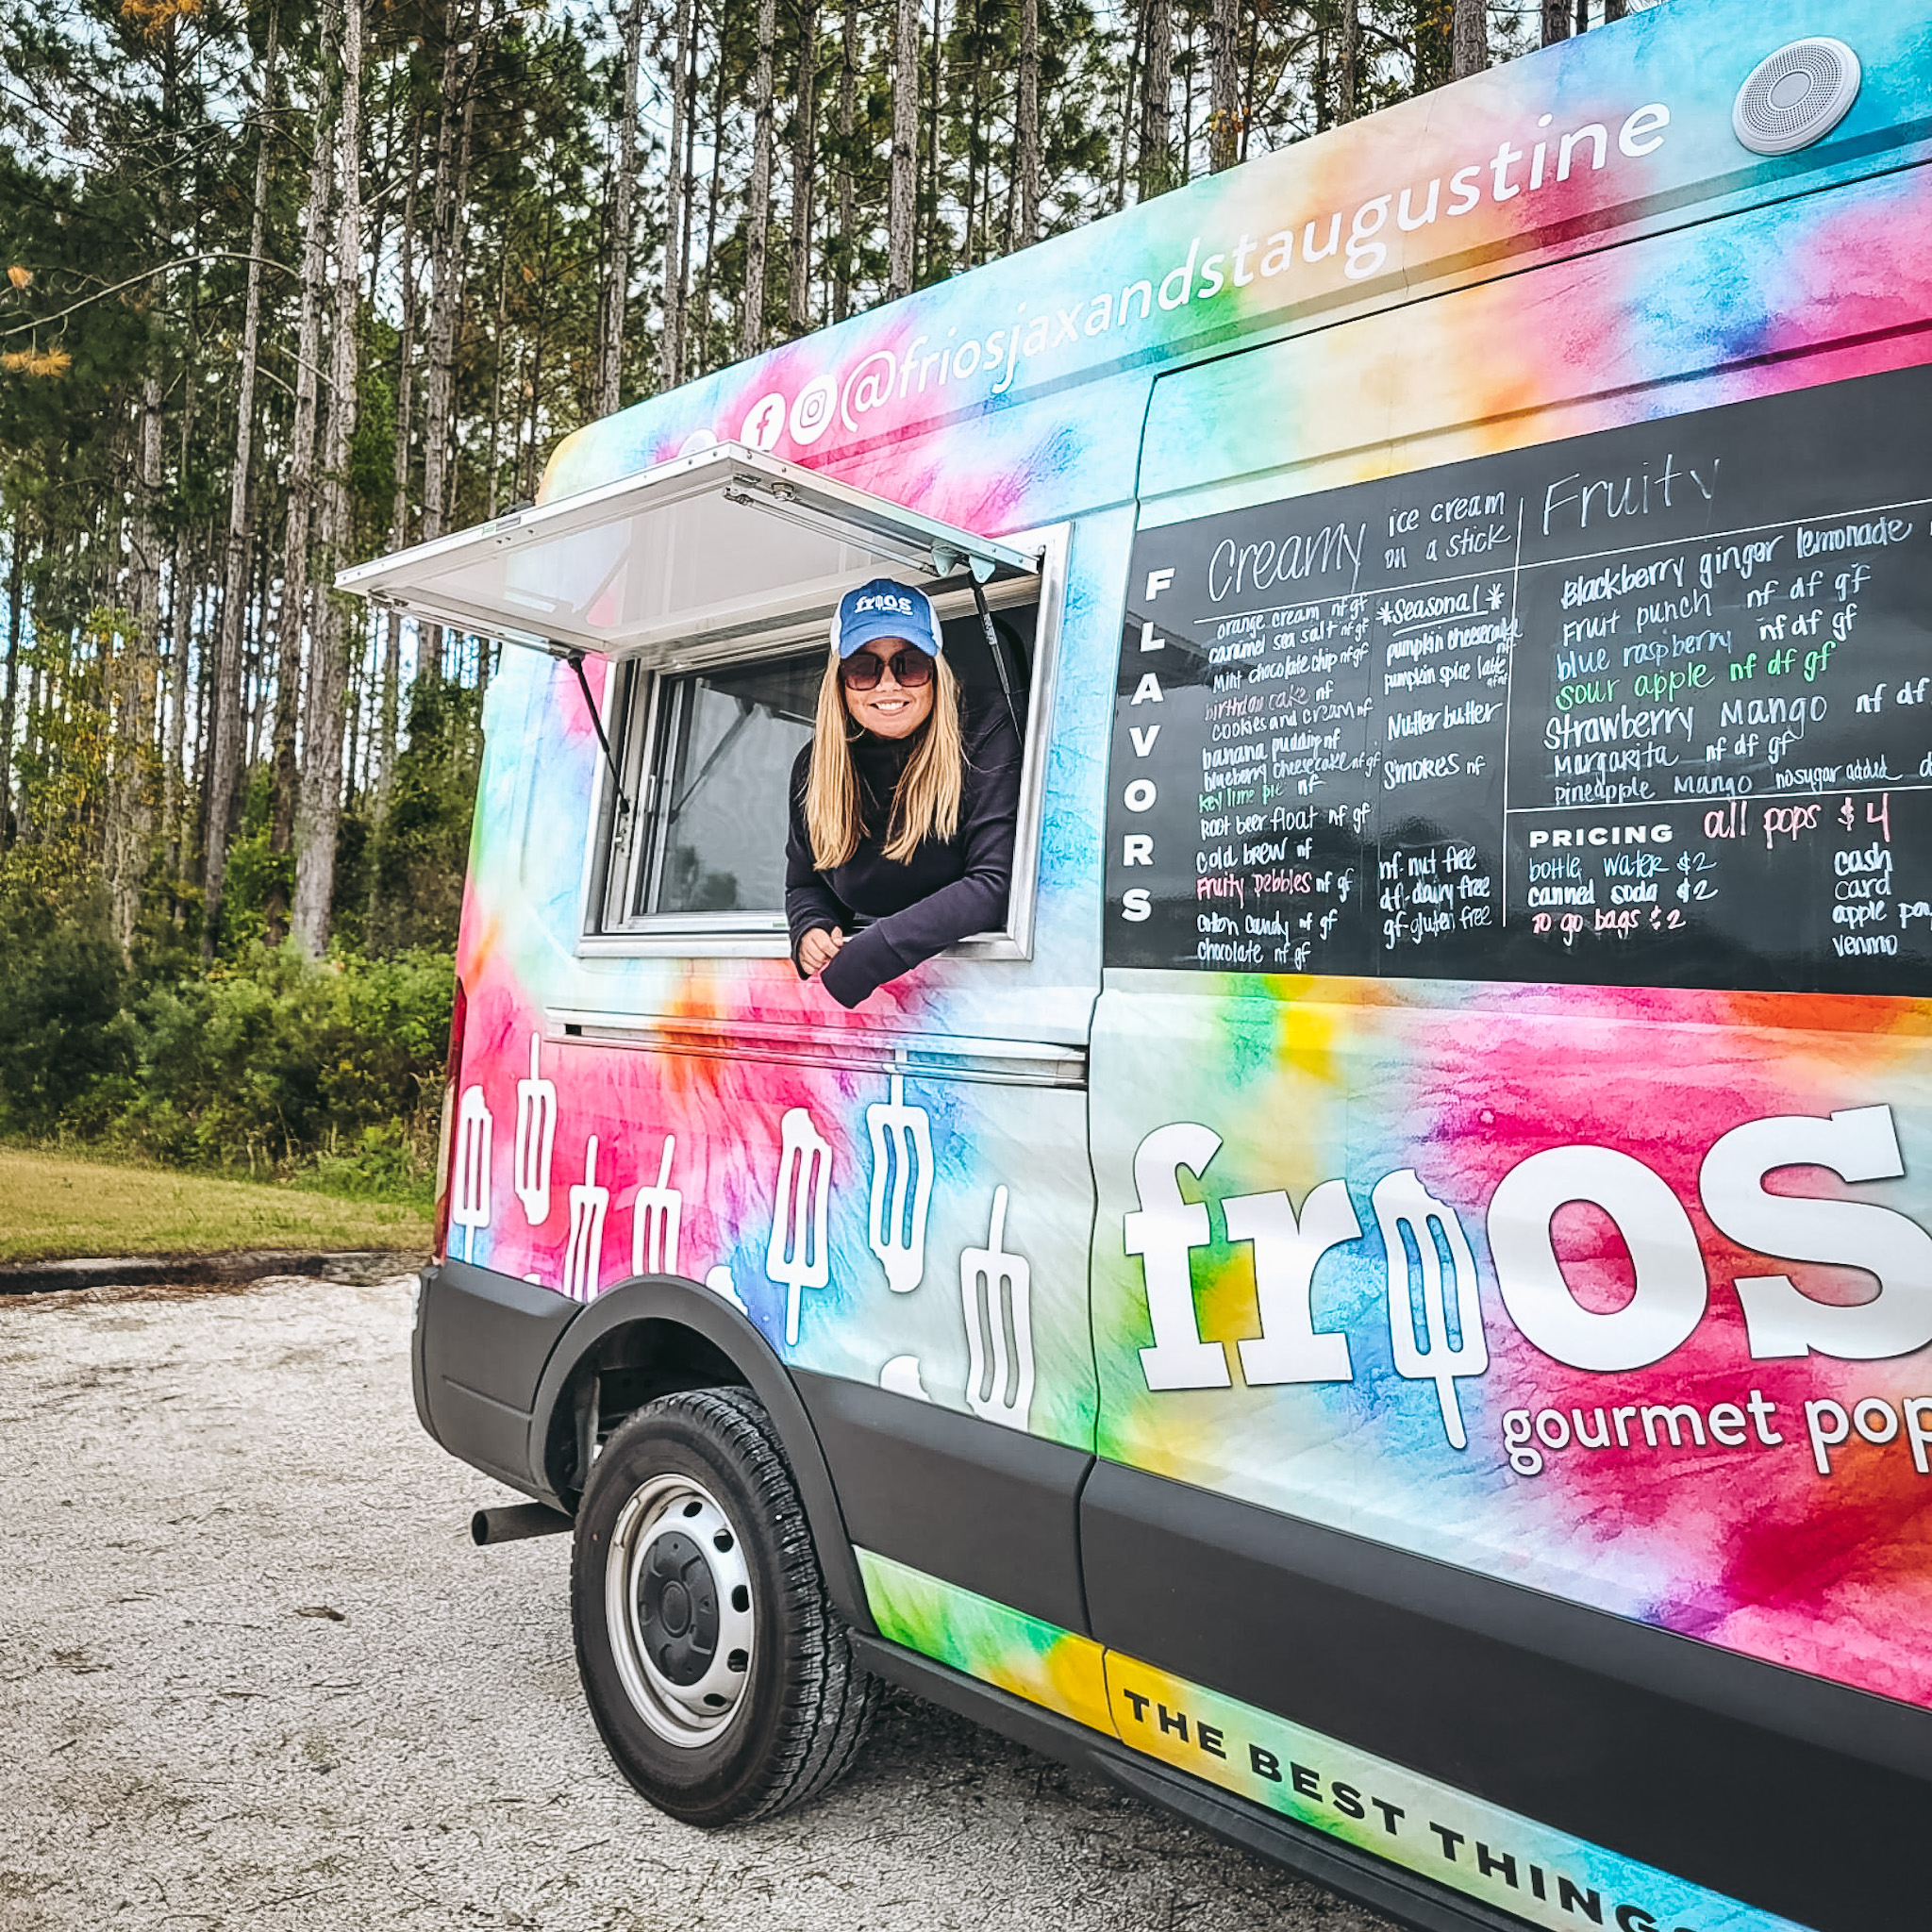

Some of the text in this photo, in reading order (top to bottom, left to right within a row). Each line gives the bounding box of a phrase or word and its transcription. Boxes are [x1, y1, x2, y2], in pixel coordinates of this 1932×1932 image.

[841, 102, 1672, 433] @friosjaxandstaugustine
[1389, 490, 1506, 538] ice cream
[1541, 453, 1721, 538] Fruity
[1208, 522, 1366, 602] Creamy
[1384, 523, 1511, 570] on a stick
[1560, 516, 1913, 609] Blackberry ginger lemonade
[1217, 594, 1368, 640] orange cream nf gf
[1563, 565, 1871, 647] Fruit punch nf df gf
[1274, 633, 1296, 651] sea
[1300, 621, 1338, 643] salt
[1341, 623, 1354, 637] nf
[1355, 618, 1369, 641] gf
[1386, 628, 1445, 667] pumpkin
[1447, 617, 1524, 650] cheesecake
[1557, 603, 1857, 681] blue raspberry nf df gf
[1248, 655, 1312, 684] chocolate
[1311, 648, 1339, 673] chip
[1340, 647, 1353, 664] nf
[1352, 642, 1369, 668] gf
[1384, 664, 1436, 695] pumpkin
[1440, 660, 1472, 688] spice
[1477, 655, 1507, 679] latte
[1556, 641, 1837, 711] sour apple nf df gf
[1269, 684, 1311, 710] cake
[1315, 680, 1334, 705] nf
[1270, 710, 1297, 730] and
[1303, 701, 1355, 724] cream
[1357, 697, 1374, 717] nf
[1542, 704, 1693, 750] Strawberry
[1856, 683, 1887, 713] nf
[1896, 677, 1930, 705] df
[1388, 700, 1504, 741] Nutter butter
[1121, 567, 1175, 923] FLAVORS
[1202, 742, 1269, 770] banana
[1324, 727, 1341, 750] nf
[1706, 736, 1727, 762] nf
[1734, 733, 1759, 758] df
[1768, 730, 1794, 765] gf
[1204, 763, 1268, 792] blueberry
[1273, 752, 1353, 779] cheesecake
[1365, 752, 1381, 778] gf
[1466, 756, 1486, 776] nf
[1262, 781, 1288, 805] pie
[1297, 774, 1326, 796] nf
[1555, 774, 1657, 806] pineapple
[1236, 814, 1268, 835] beer
[1270, 805, 1319, 831] float
[1328, 804, 1347, 827] nf
[1353, 802, 1371, 834] gf
[1529, 824, 1674, 848] PRICING
[1703, 799, 1747, 839] all
[1762, 804, 1822, 849] pops
[1297, 837, 1313, 859] nf
[1441, 846, 1477, 873] free
[1528, 853, 1582, 882] bottle
[1834, 841, 1893, 876] cash
[1315, 871, 1333, 893] nf
[1337, 867, 1354, 903] gf
[1457, 874, 1491, 899] free
[1527, 878, 1595, 908] canned
[1610, 879, 1657, 905] soda
[1834, 869, 1891, 900] card
[1197, 908, 1338, 943] cotton candy nf gf
[1459, 906, 1492, 929] free
[1560, 913, 1584, 947] go
[1594, 908, 1641, 939] bags
[1832, 900, 1888, 929] apple
[1197, 937, 1311, 971] chocolate nf gf
[1502, 1390, 1784, 1476] gourmet
[1124, 1688, 1226, 1760] THE
[1249, 1741, 1406, 1837] BEST
